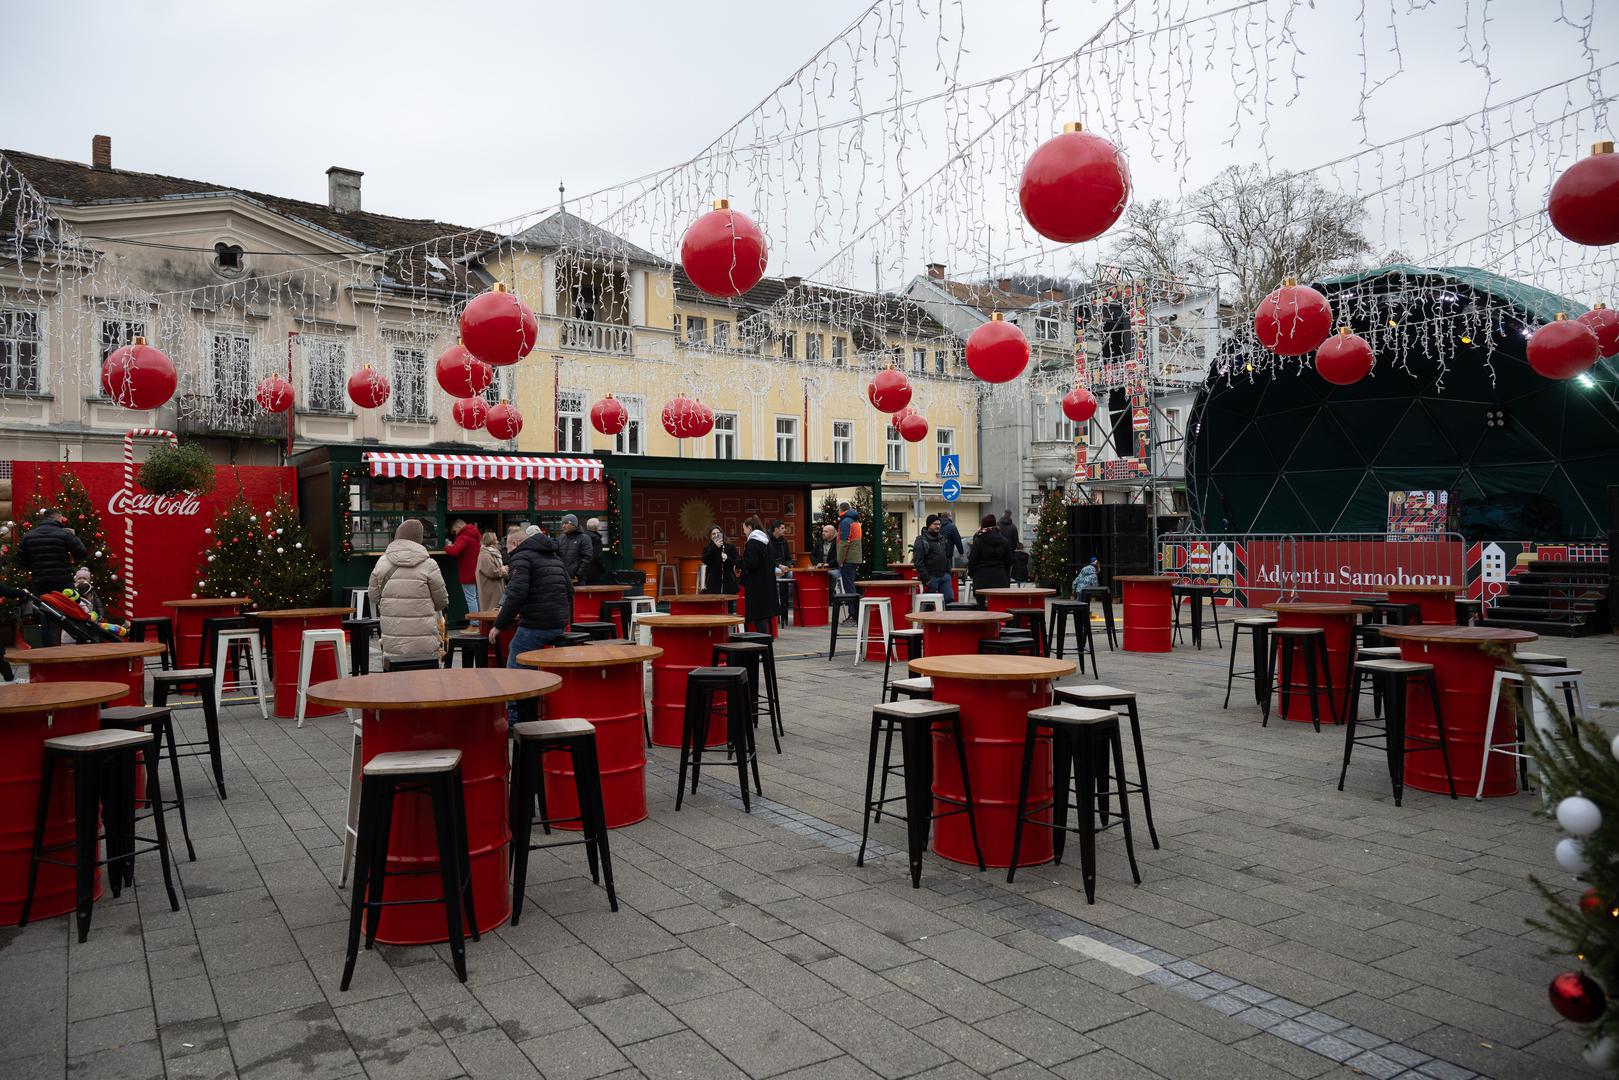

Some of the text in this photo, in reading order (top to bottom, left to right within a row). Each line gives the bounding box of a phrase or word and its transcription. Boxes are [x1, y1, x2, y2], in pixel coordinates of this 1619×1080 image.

[1256, 564, 1451, 587] Advent u Samoboru
